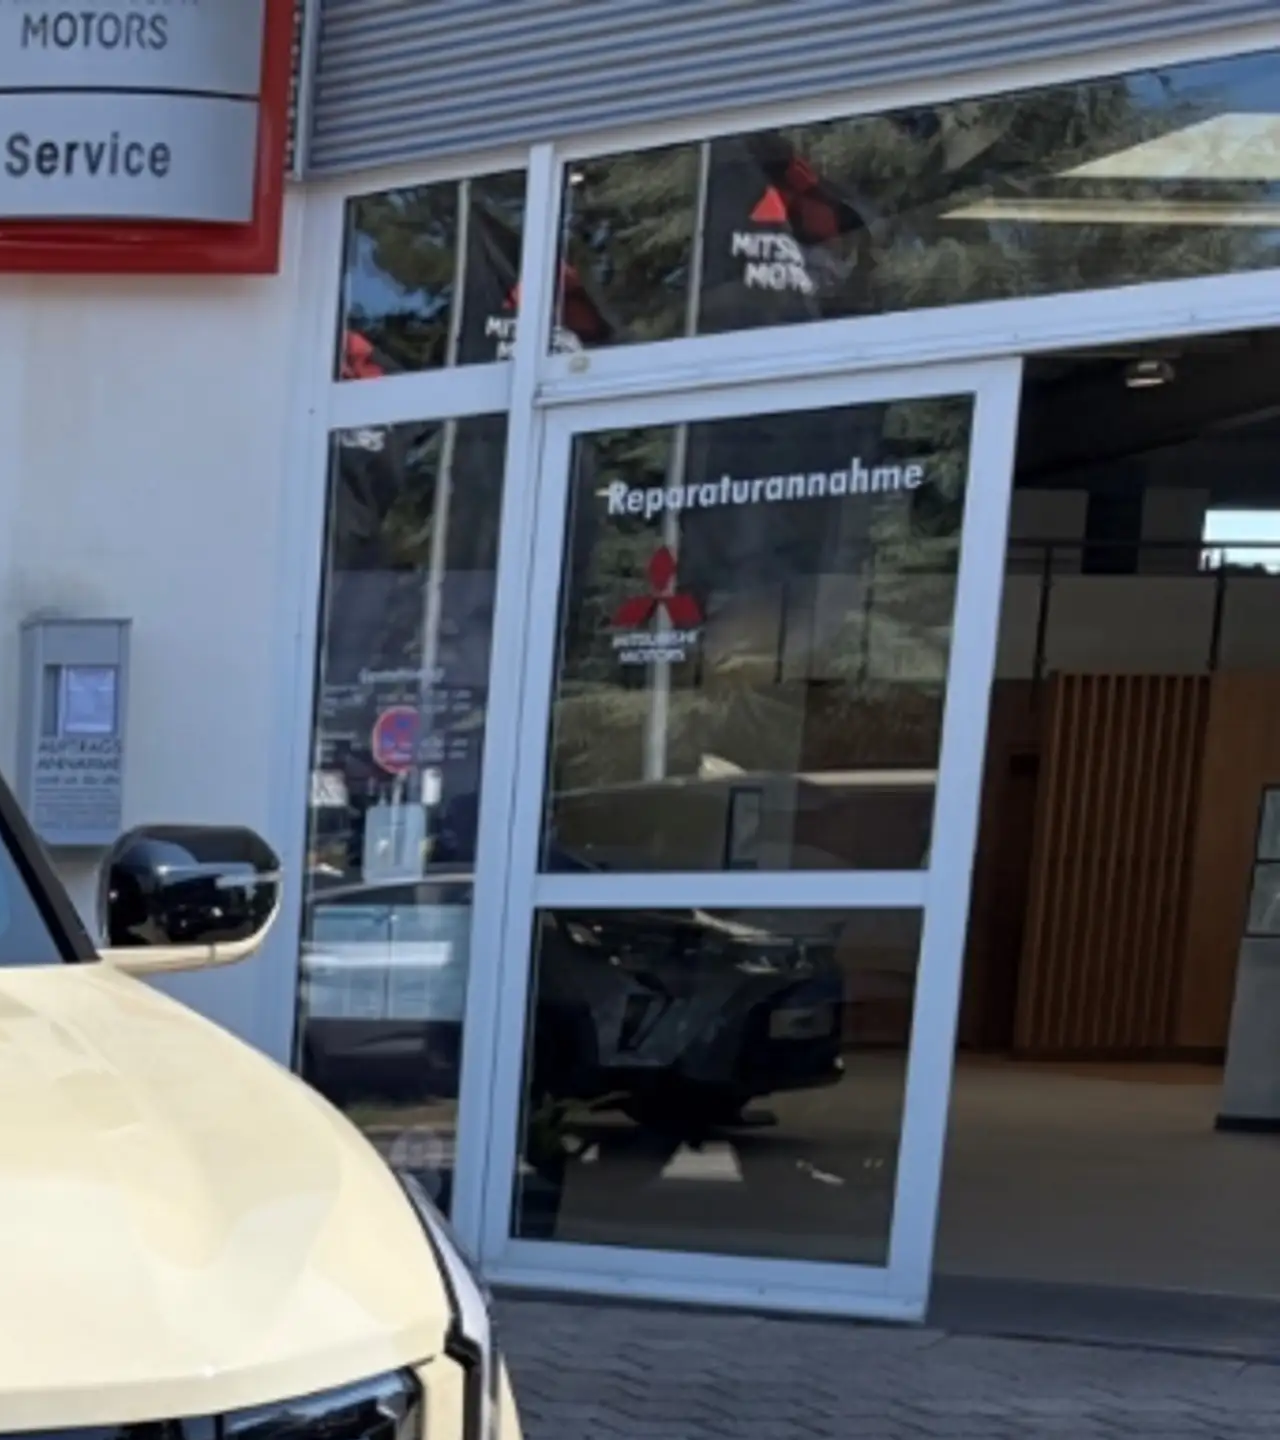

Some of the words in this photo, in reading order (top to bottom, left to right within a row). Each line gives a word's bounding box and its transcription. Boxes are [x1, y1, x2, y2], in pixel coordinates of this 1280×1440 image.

[21, 11, 168, 51] MOTORS
[5, 131, 172, 178] Service
[608, 457, 924, 518] Reparaturannahme
